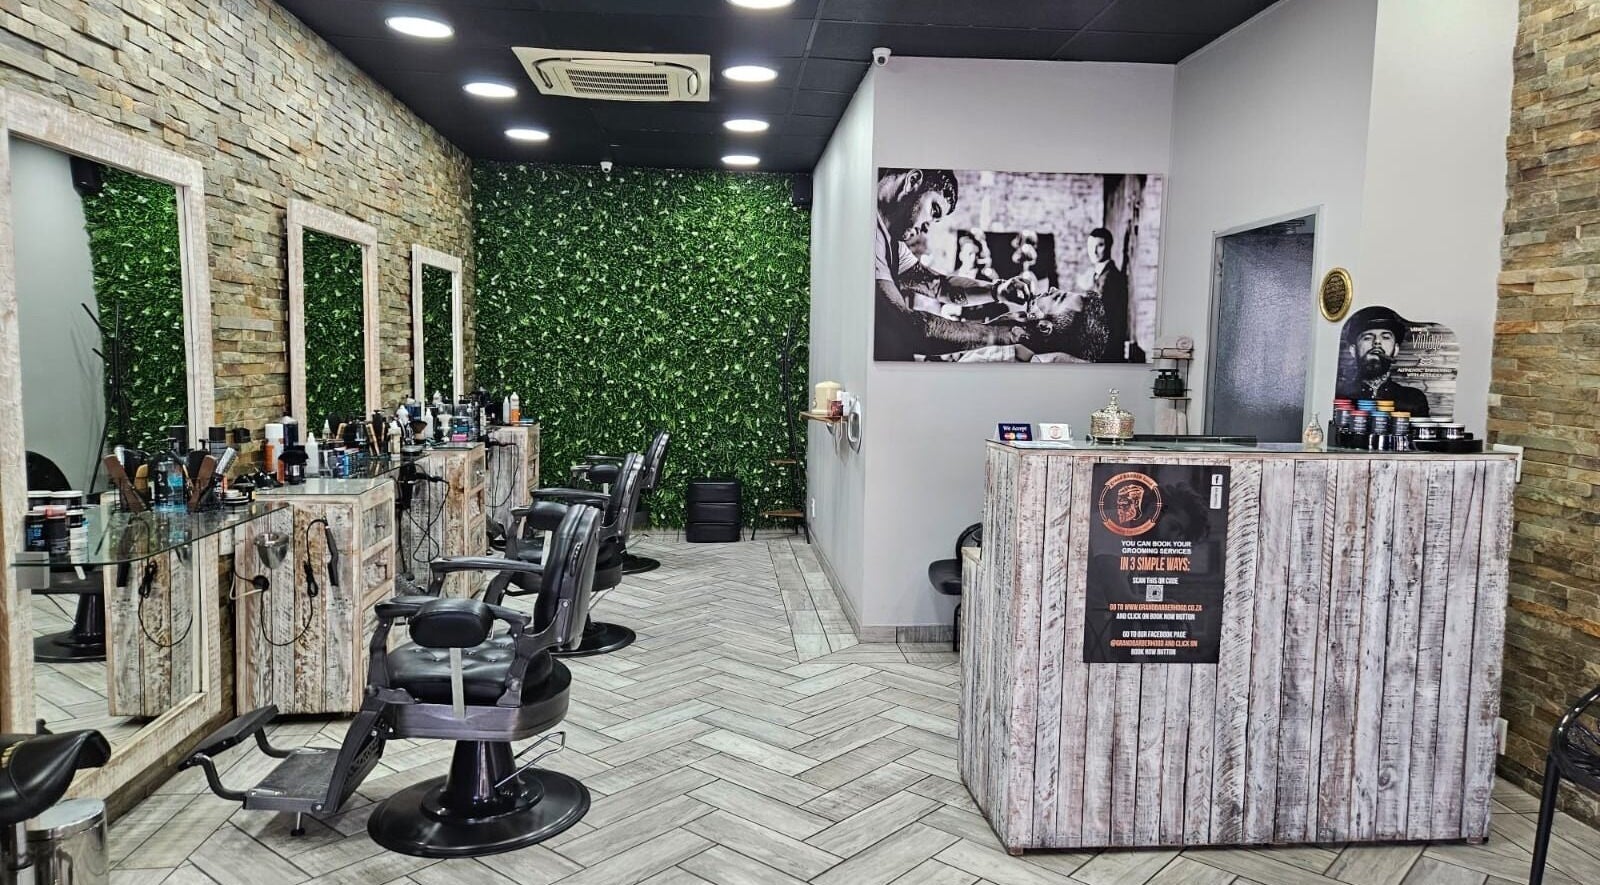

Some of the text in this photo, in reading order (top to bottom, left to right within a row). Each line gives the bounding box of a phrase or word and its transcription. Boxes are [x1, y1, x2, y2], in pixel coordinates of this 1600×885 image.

[1120, 557, 1190, 571] IN 3 SIMPLE WAYS:
